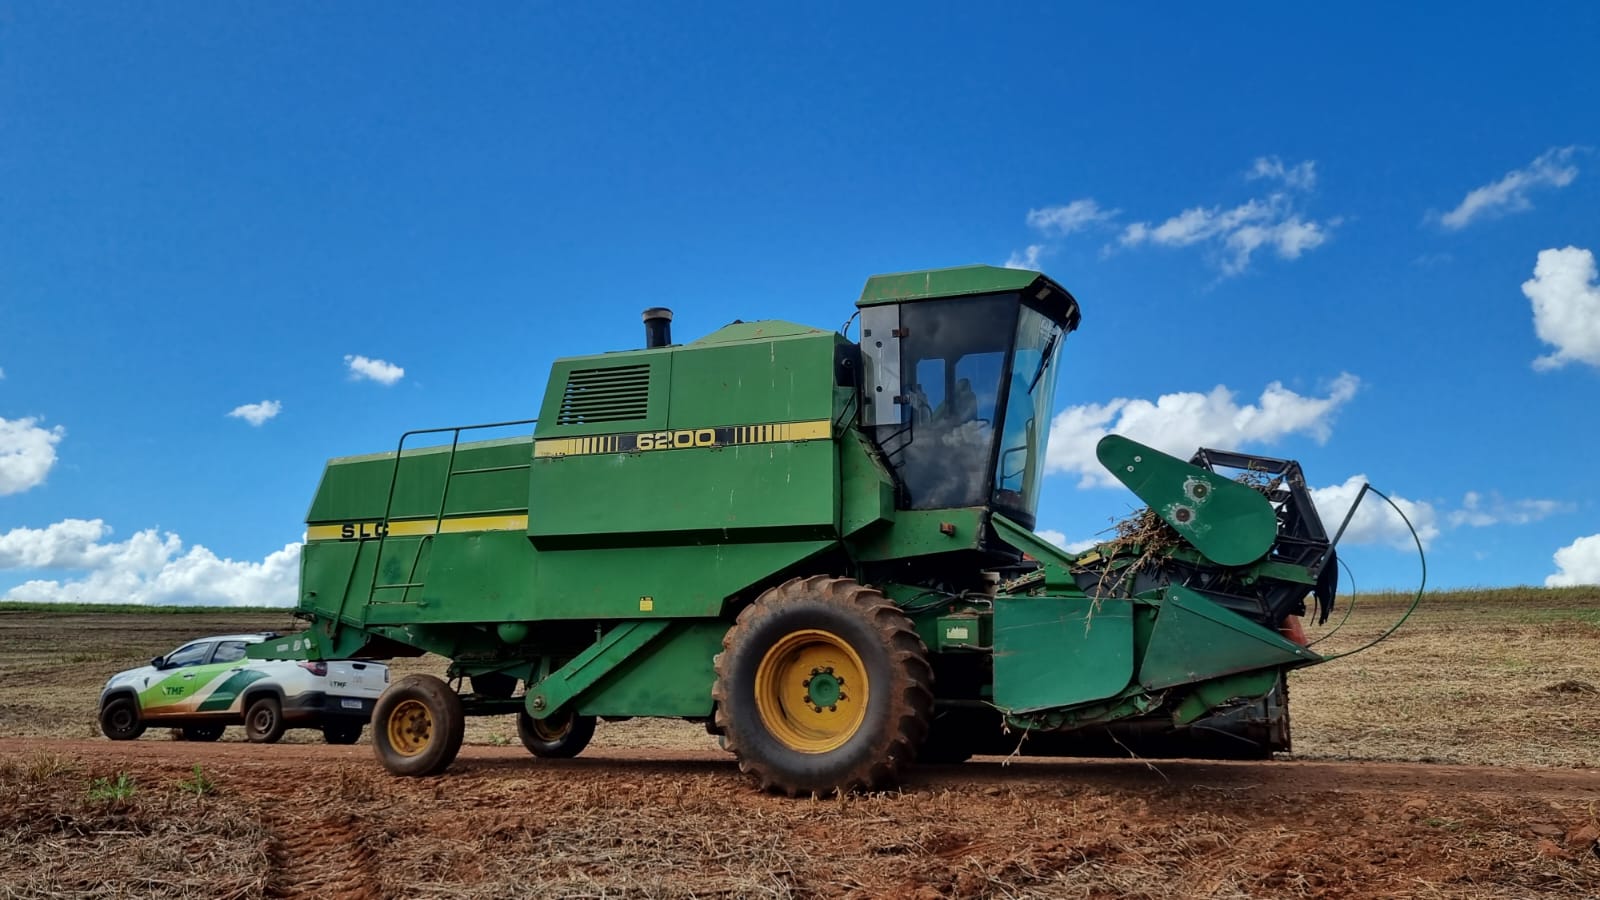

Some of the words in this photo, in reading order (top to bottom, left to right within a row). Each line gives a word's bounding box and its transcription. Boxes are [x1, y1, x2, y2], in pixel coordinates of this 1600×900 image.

[636, 428, 716, 451] 6200
[341, 522, 389, 538] SLC
[166, 686, 185, 696] TMF
